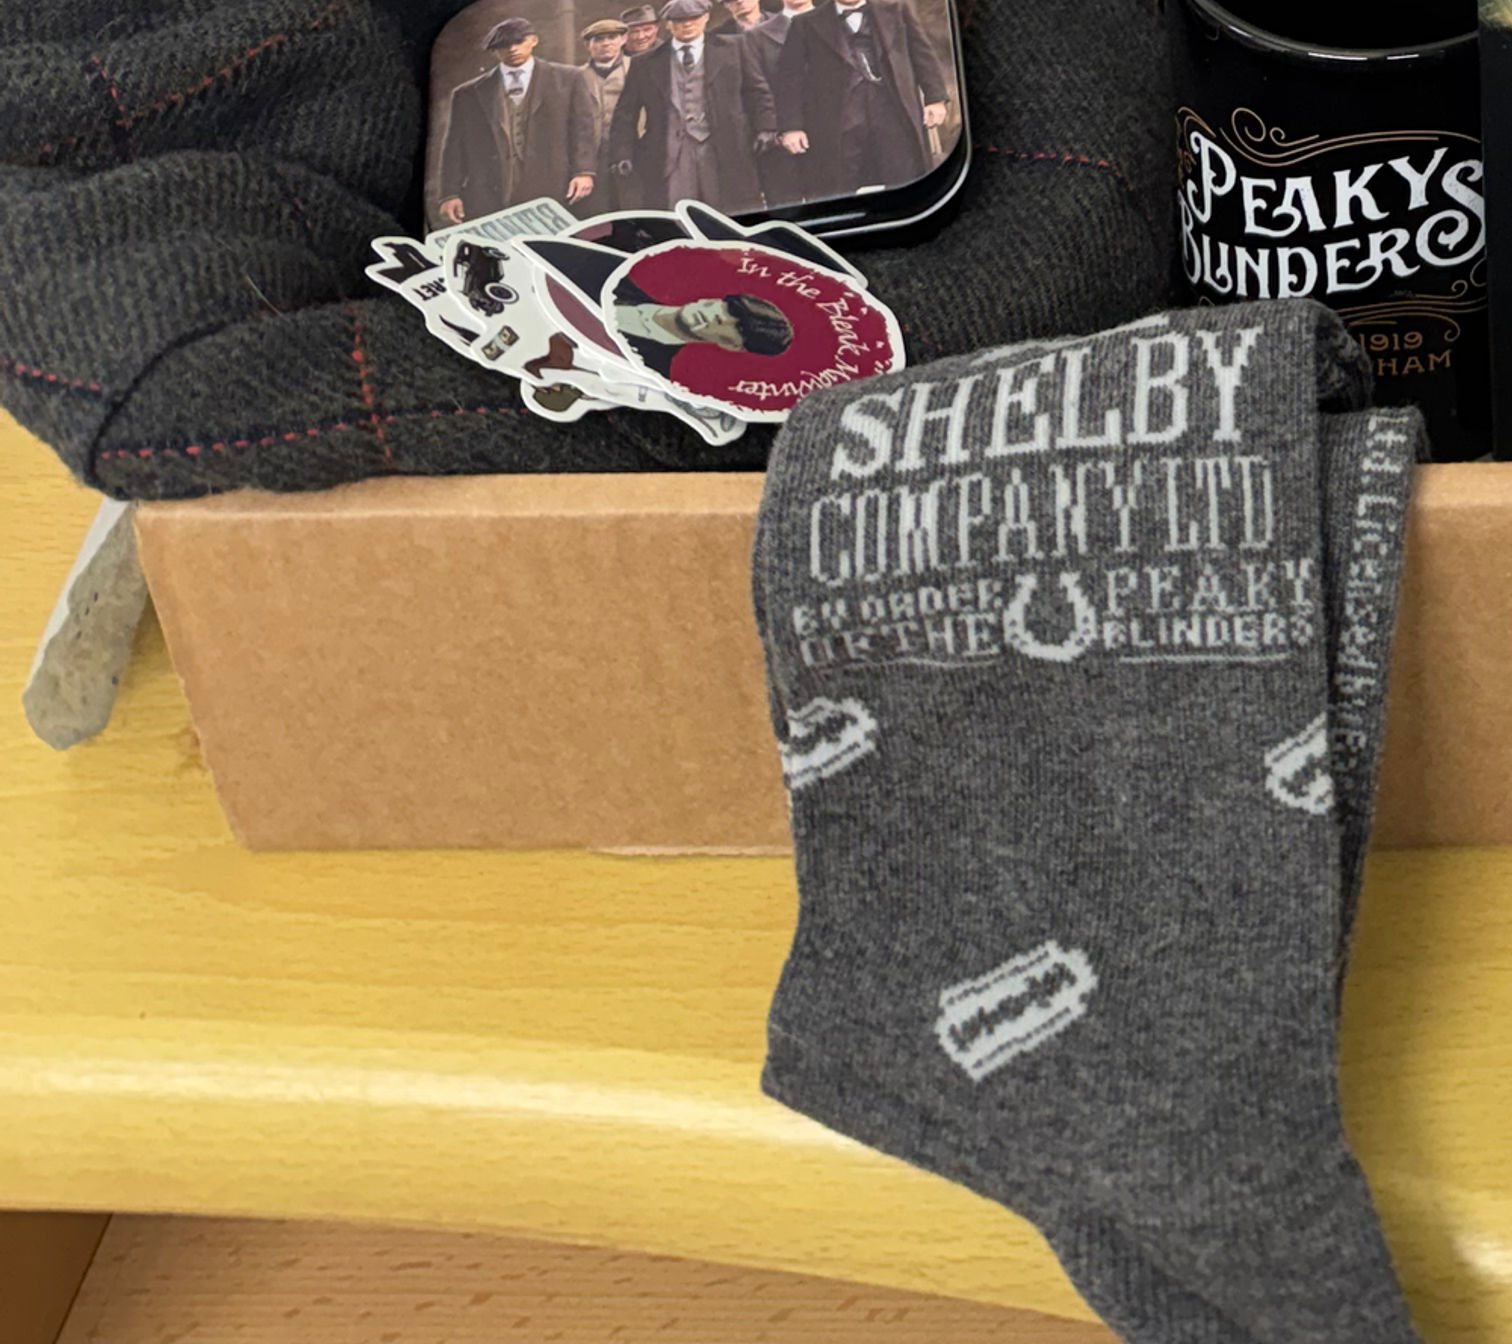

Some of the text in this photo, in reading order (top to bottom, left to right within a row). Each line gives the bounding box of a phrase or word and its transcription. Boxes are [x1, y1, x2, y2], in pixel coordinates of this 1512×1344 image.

[776, 271, 821, 300] the
[1359, 330, 1423, 352] 1919
[1376, 348, 1452, 377] HAM
[831, 324, 1264, 481] SHELBY
[811, 453, 1275, 588] COMPANY LTD
[1106, 557, 1315, 614] PEAKY
[1102, 611, 1315, 652] BLINDERS
